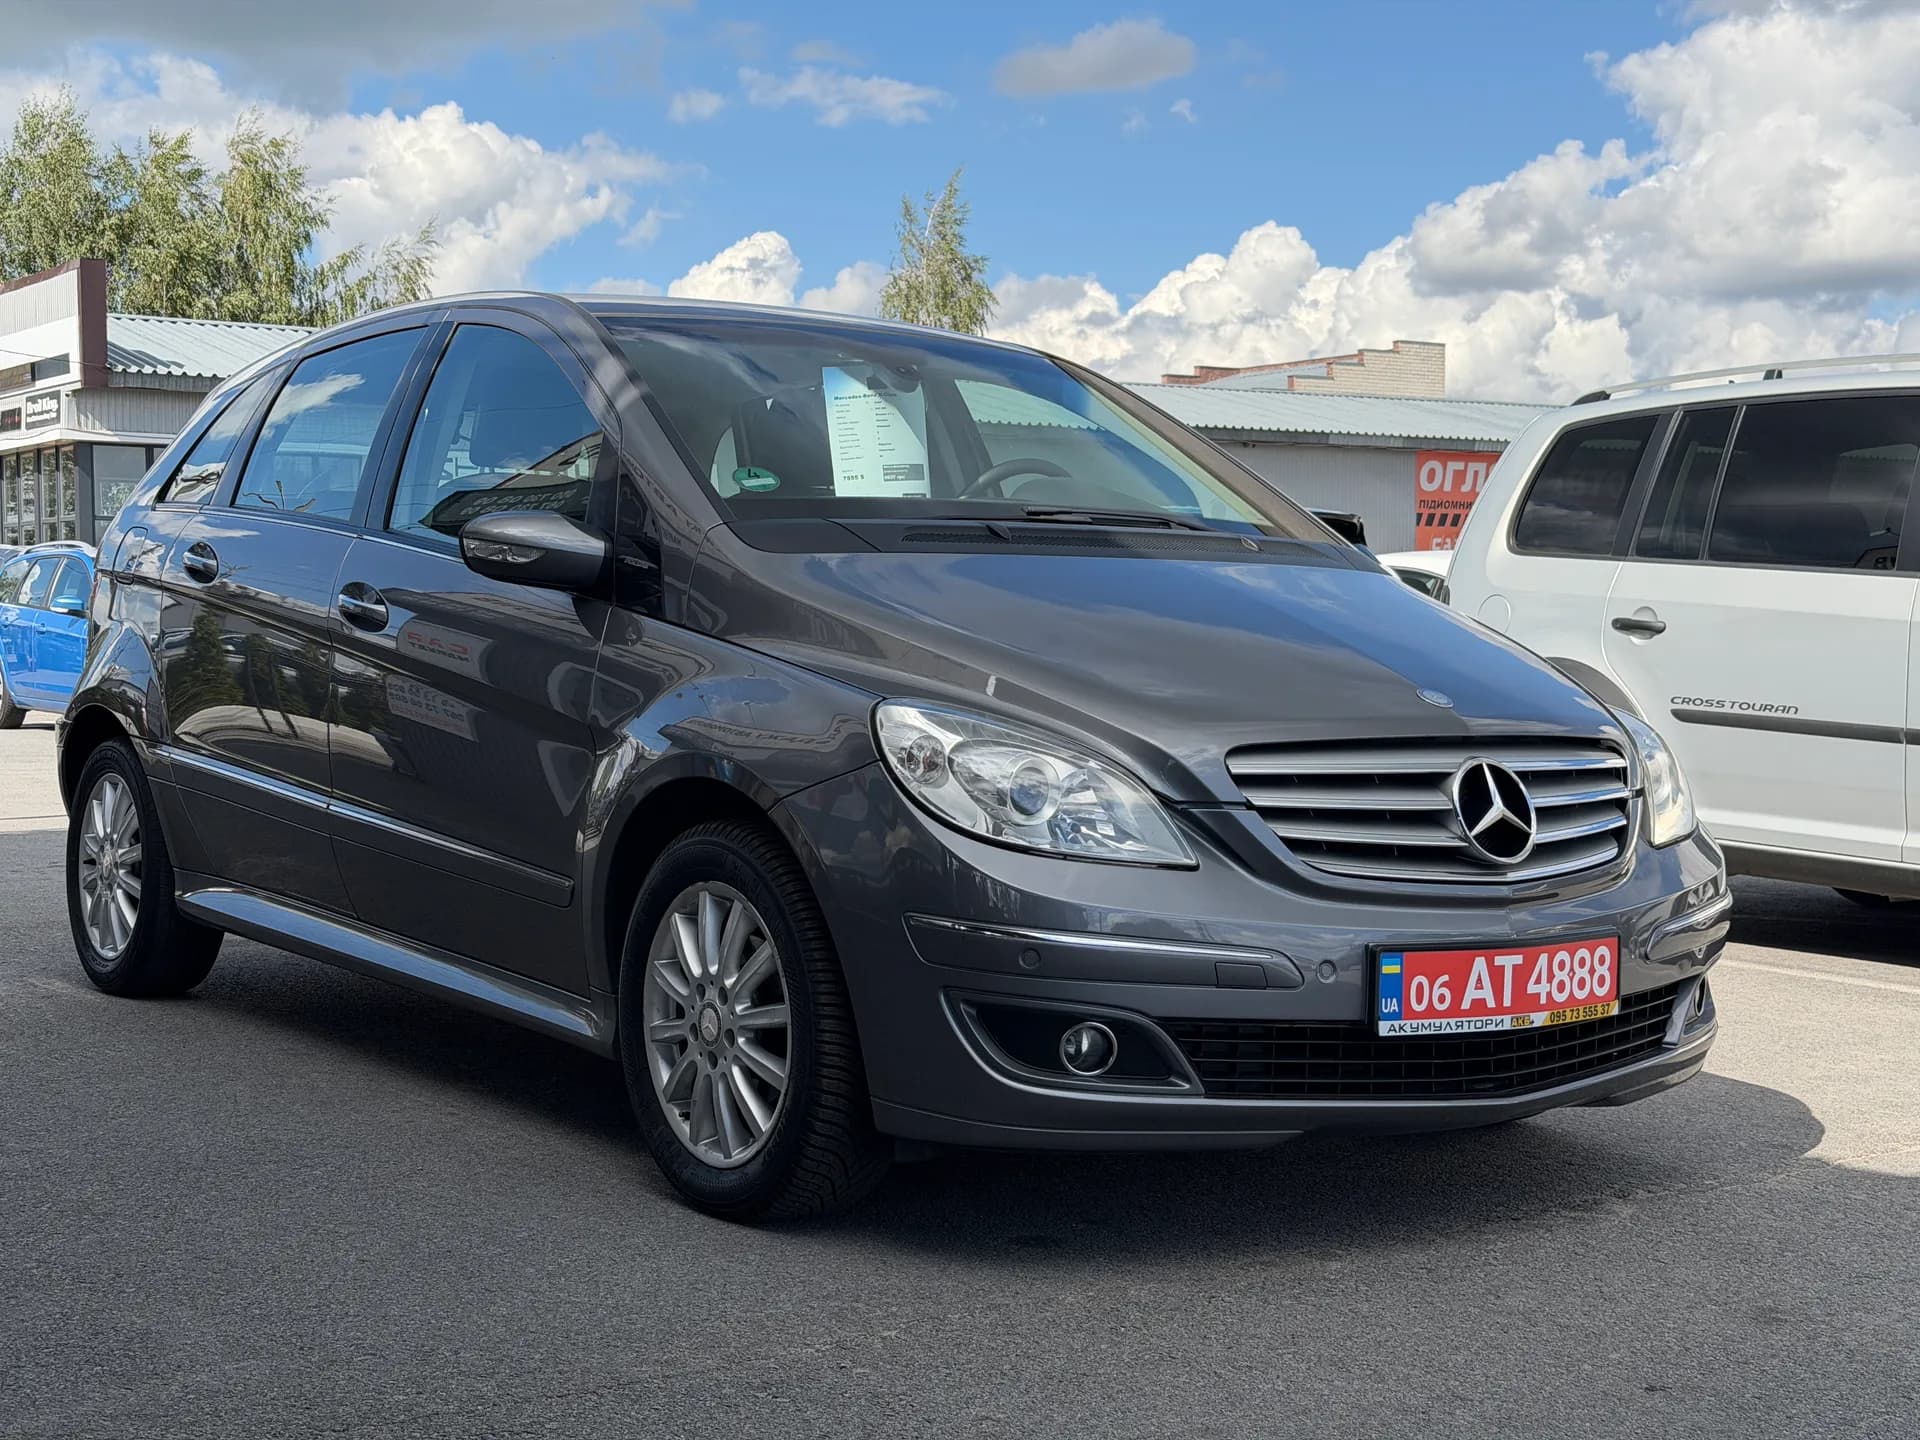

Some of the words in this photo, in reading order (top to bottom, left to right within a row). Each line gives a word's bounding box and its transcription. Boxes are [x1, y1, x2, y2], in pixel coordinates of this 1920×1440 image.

[1419, 460, 1496, 492] ОГЛ
[1409, 974, 1451, 1012] 06
[1460, 954, 1523, 1010] AT
[1527, 945, 1611, 1005] 4888
[1381, 998, 1399, 1013] UA
[1387, 1017, 1504, 1034] АКУМУЛЯТОРИ
[1550, 1010, 1567, 1024] 095
[1569, 1008, 1580, 1020] 73
[1582, 1005, 1598, 1018] 555
[1600, 1003, 1611, 1015] 37
